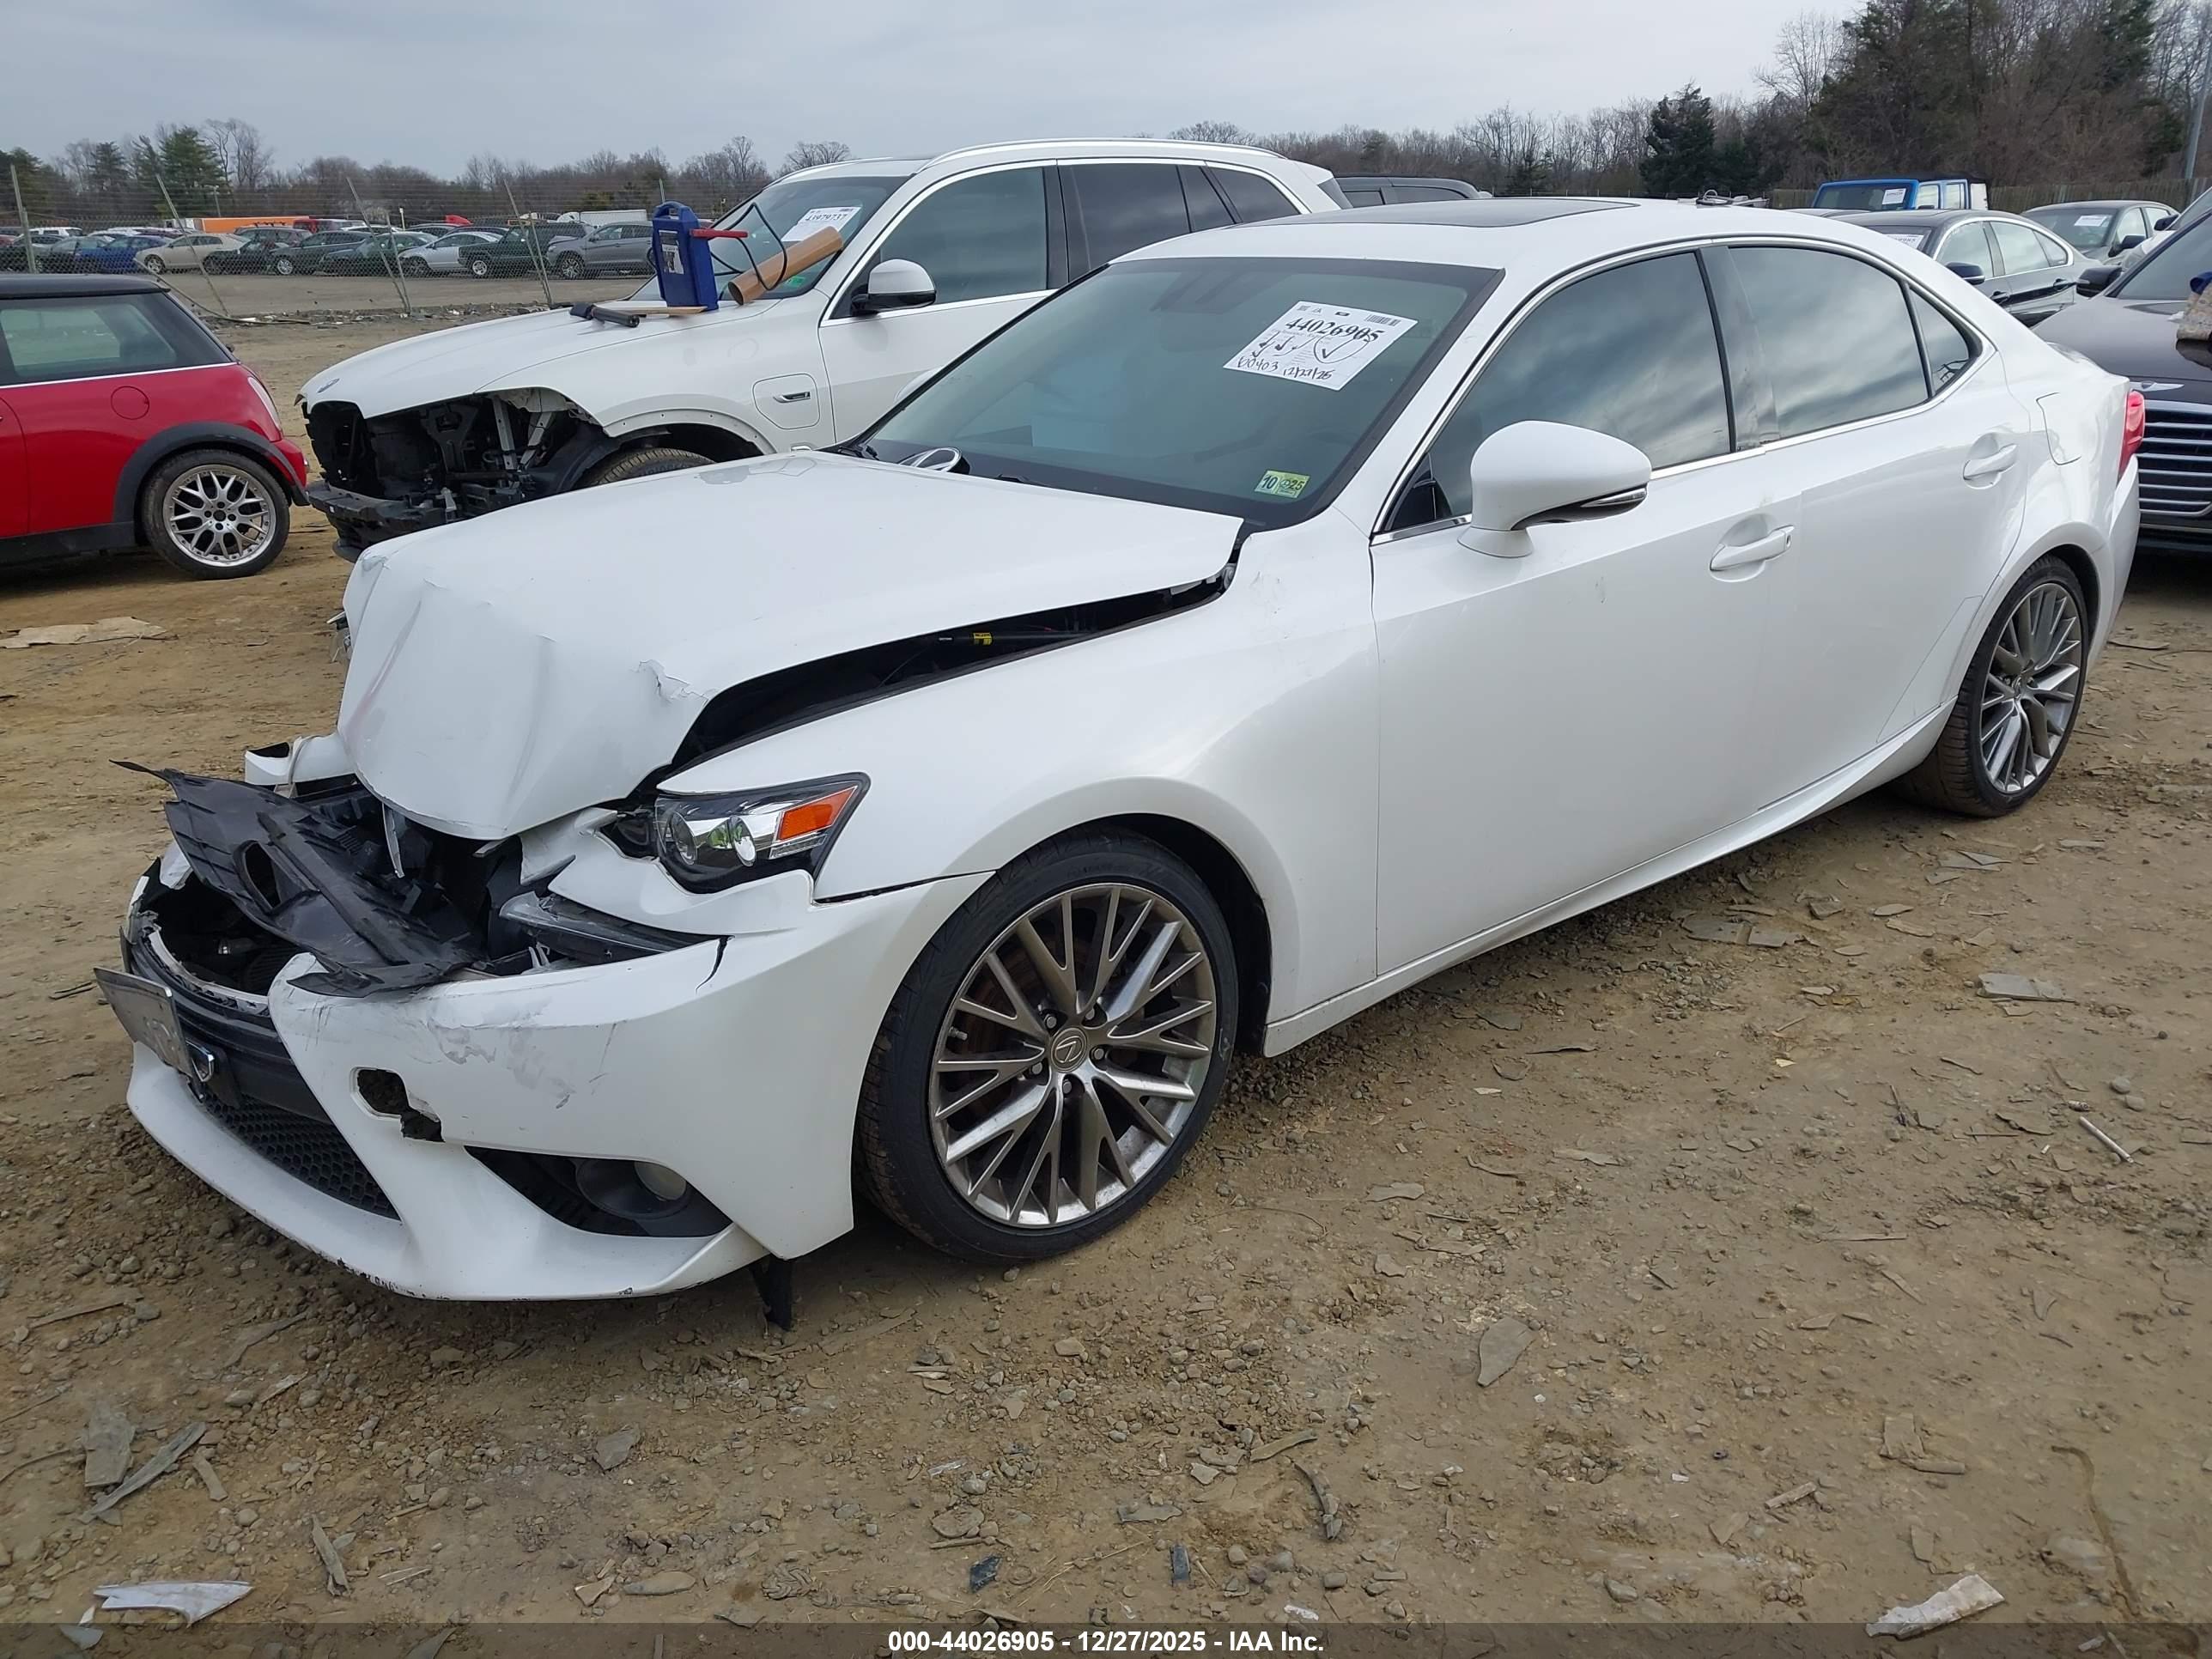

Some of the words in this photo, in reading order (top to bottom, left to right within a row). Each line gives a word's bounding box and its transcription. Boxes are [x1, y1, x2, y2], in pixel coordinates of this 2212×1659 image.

[1285, 317, 1385, 343] 44026905
[1261, 475, 1279, 489] 10
[1287, 479, 1305, 491] 25
